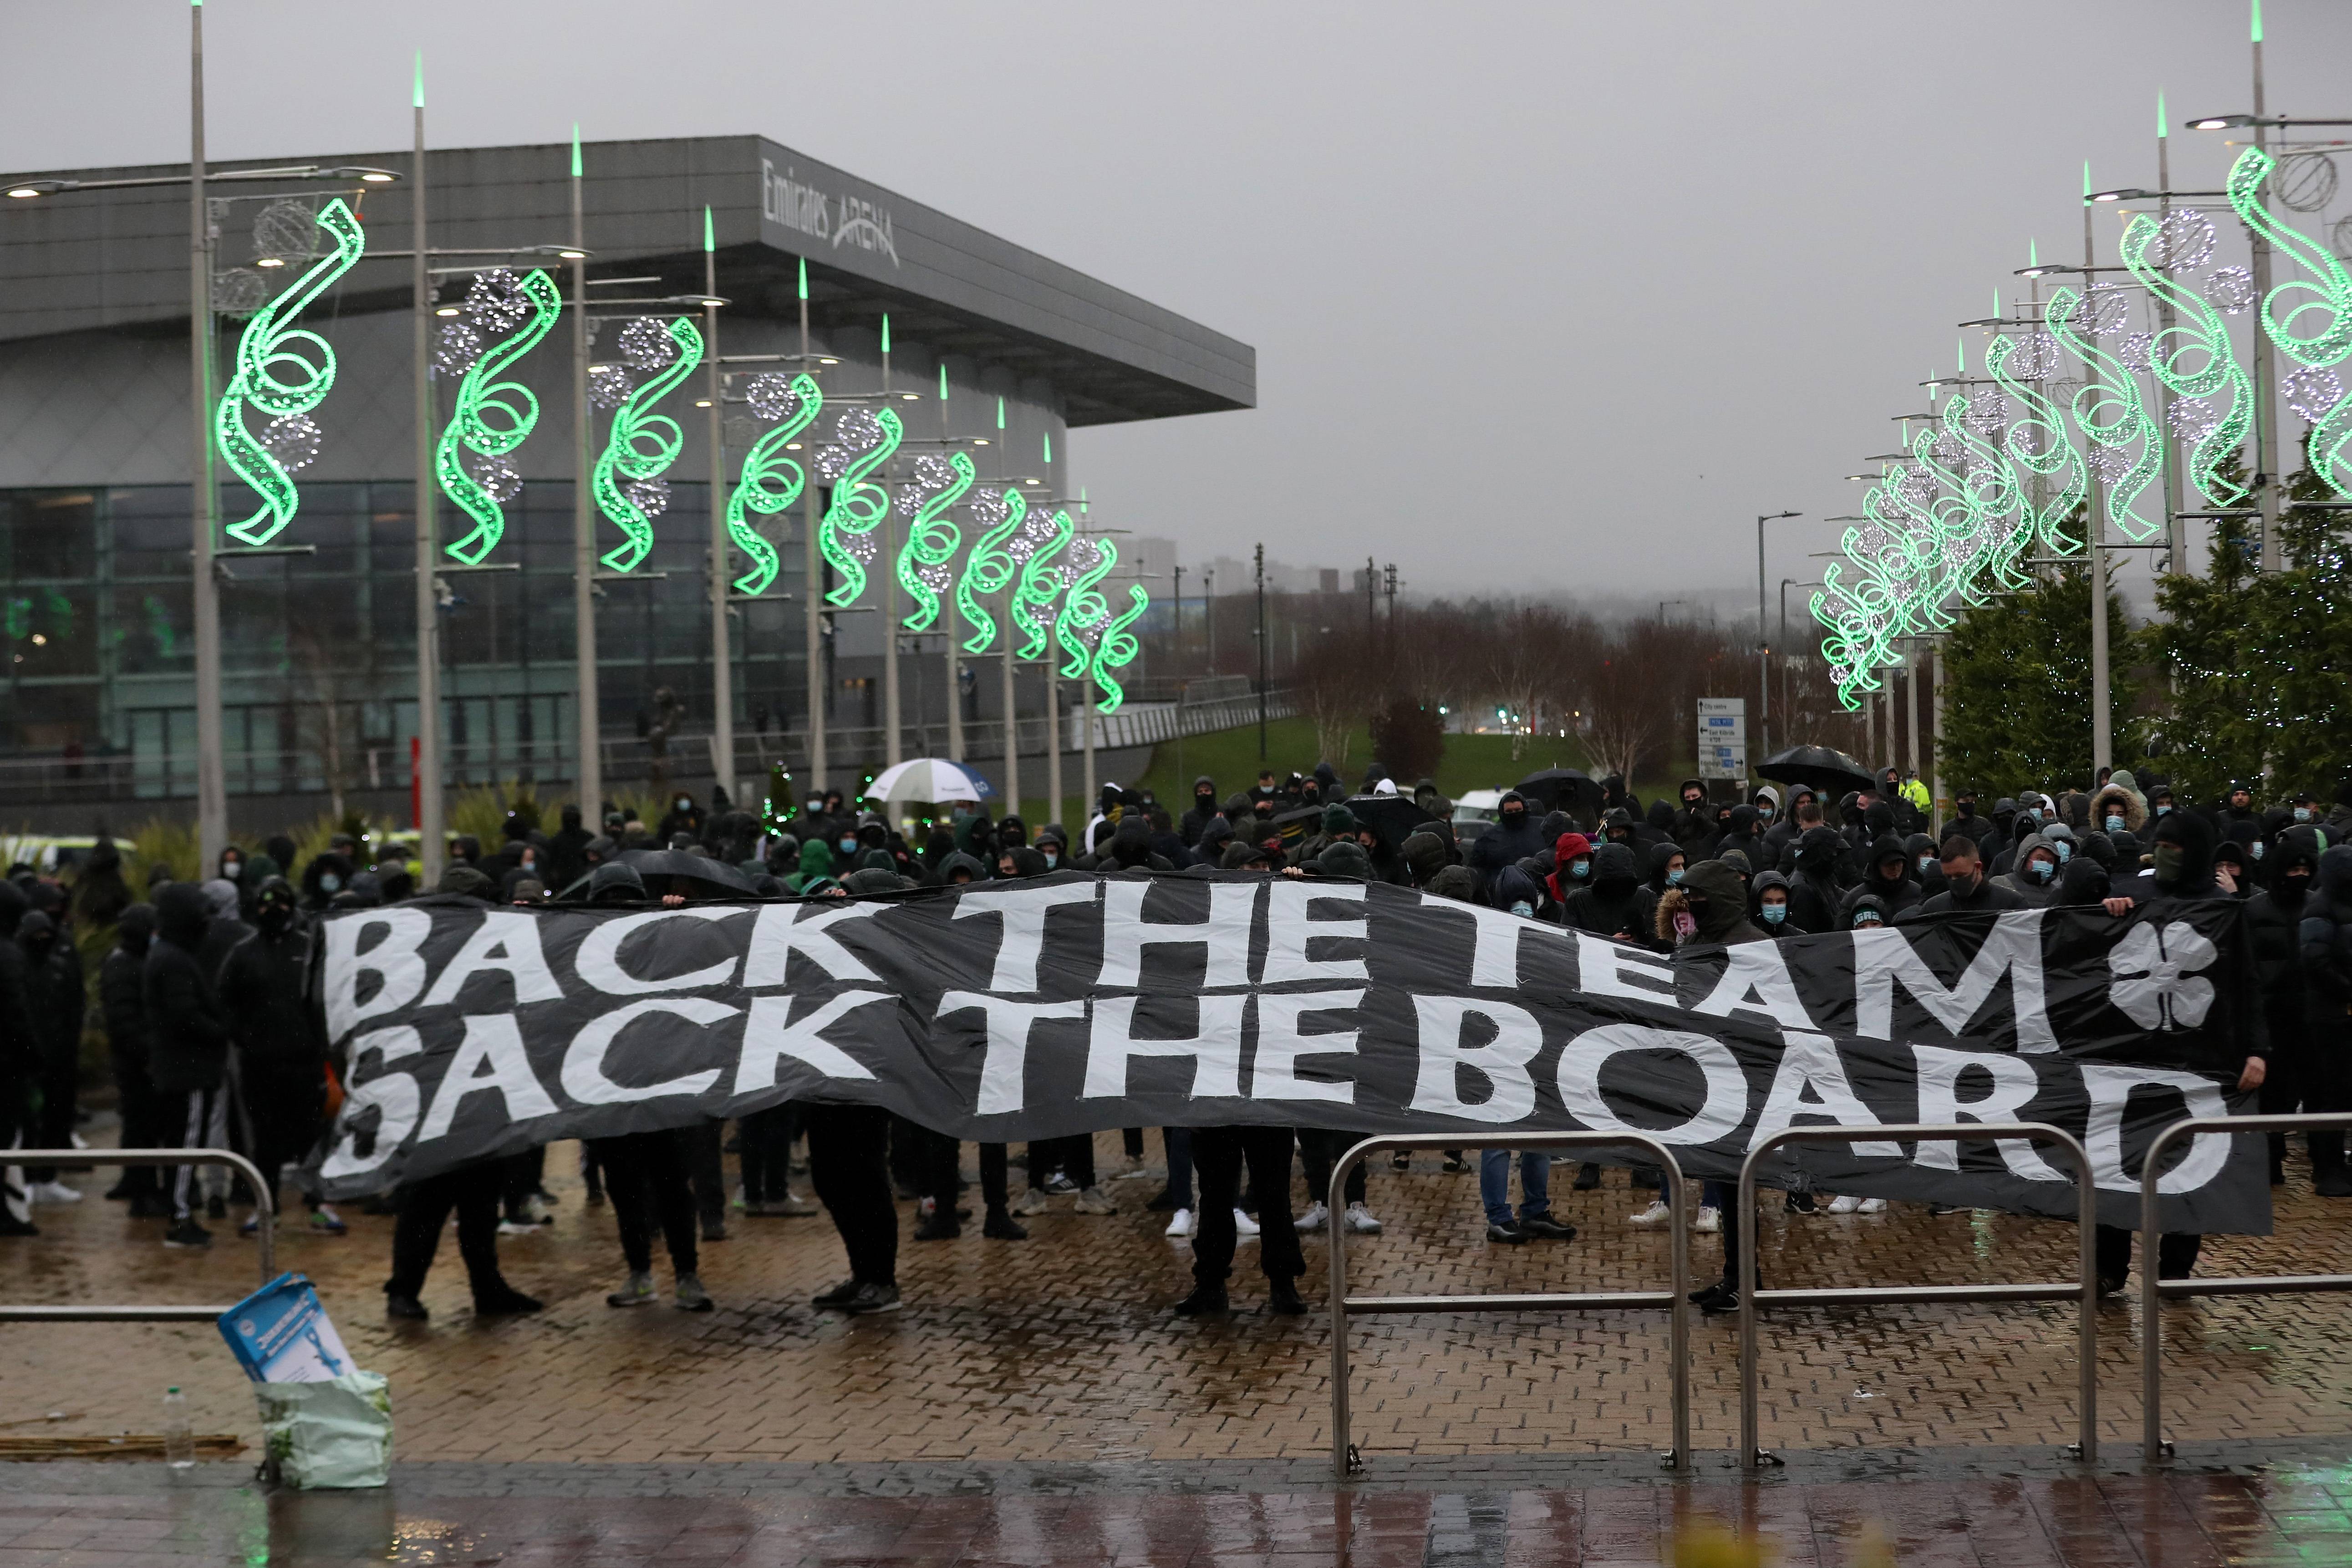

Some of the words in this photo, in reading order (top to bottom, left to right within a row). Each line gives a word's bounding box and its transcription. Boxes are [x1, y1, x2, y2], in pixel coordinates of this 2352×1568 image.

[762, 158, 829, 240] Emirates
[835, 193, 896, 256] ARENA
[324, 902, 900, 1045] BACK
[952, 880, 1369, 993] THE
[1421, 893, 2060, 1054] TEAM
[320, 990, 901, 1178] SACK
[936, 988, 1366, 1115] THE
[1409, 994, 2232, 1194] BOARD
